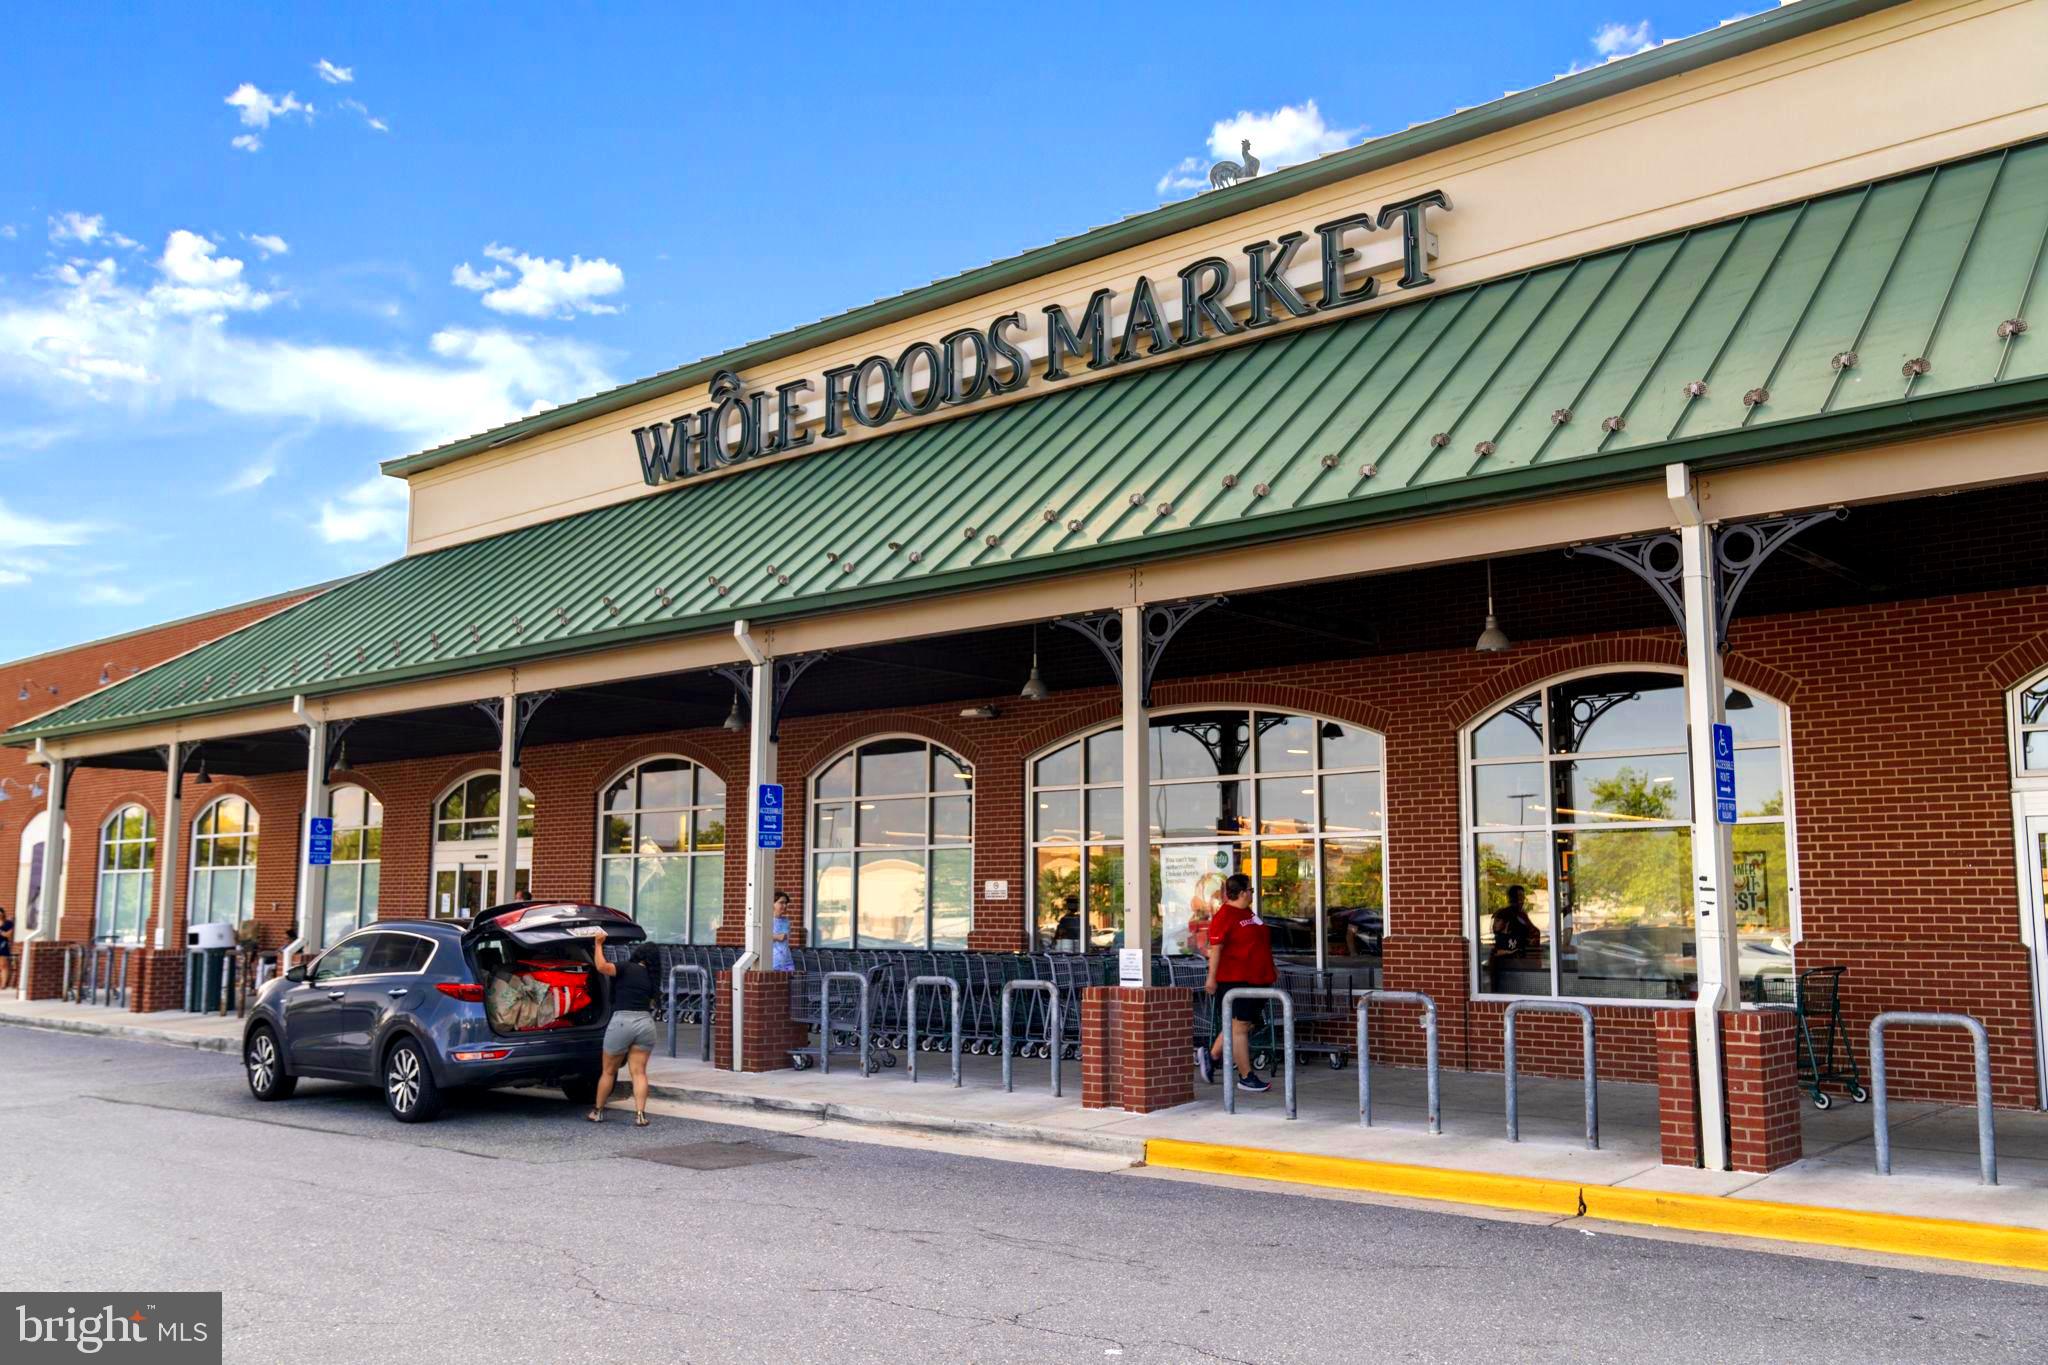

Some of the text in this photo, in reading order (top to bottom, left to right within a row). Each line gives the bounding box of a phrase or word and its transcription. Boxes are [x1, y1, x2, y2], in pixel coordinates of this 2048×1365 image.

[631, 189, 1453, 486] WHOLE FOODS MARKET
[1720, 772, 1731, 782] ROUTE
[1734, 892, 1758, 911] ST
